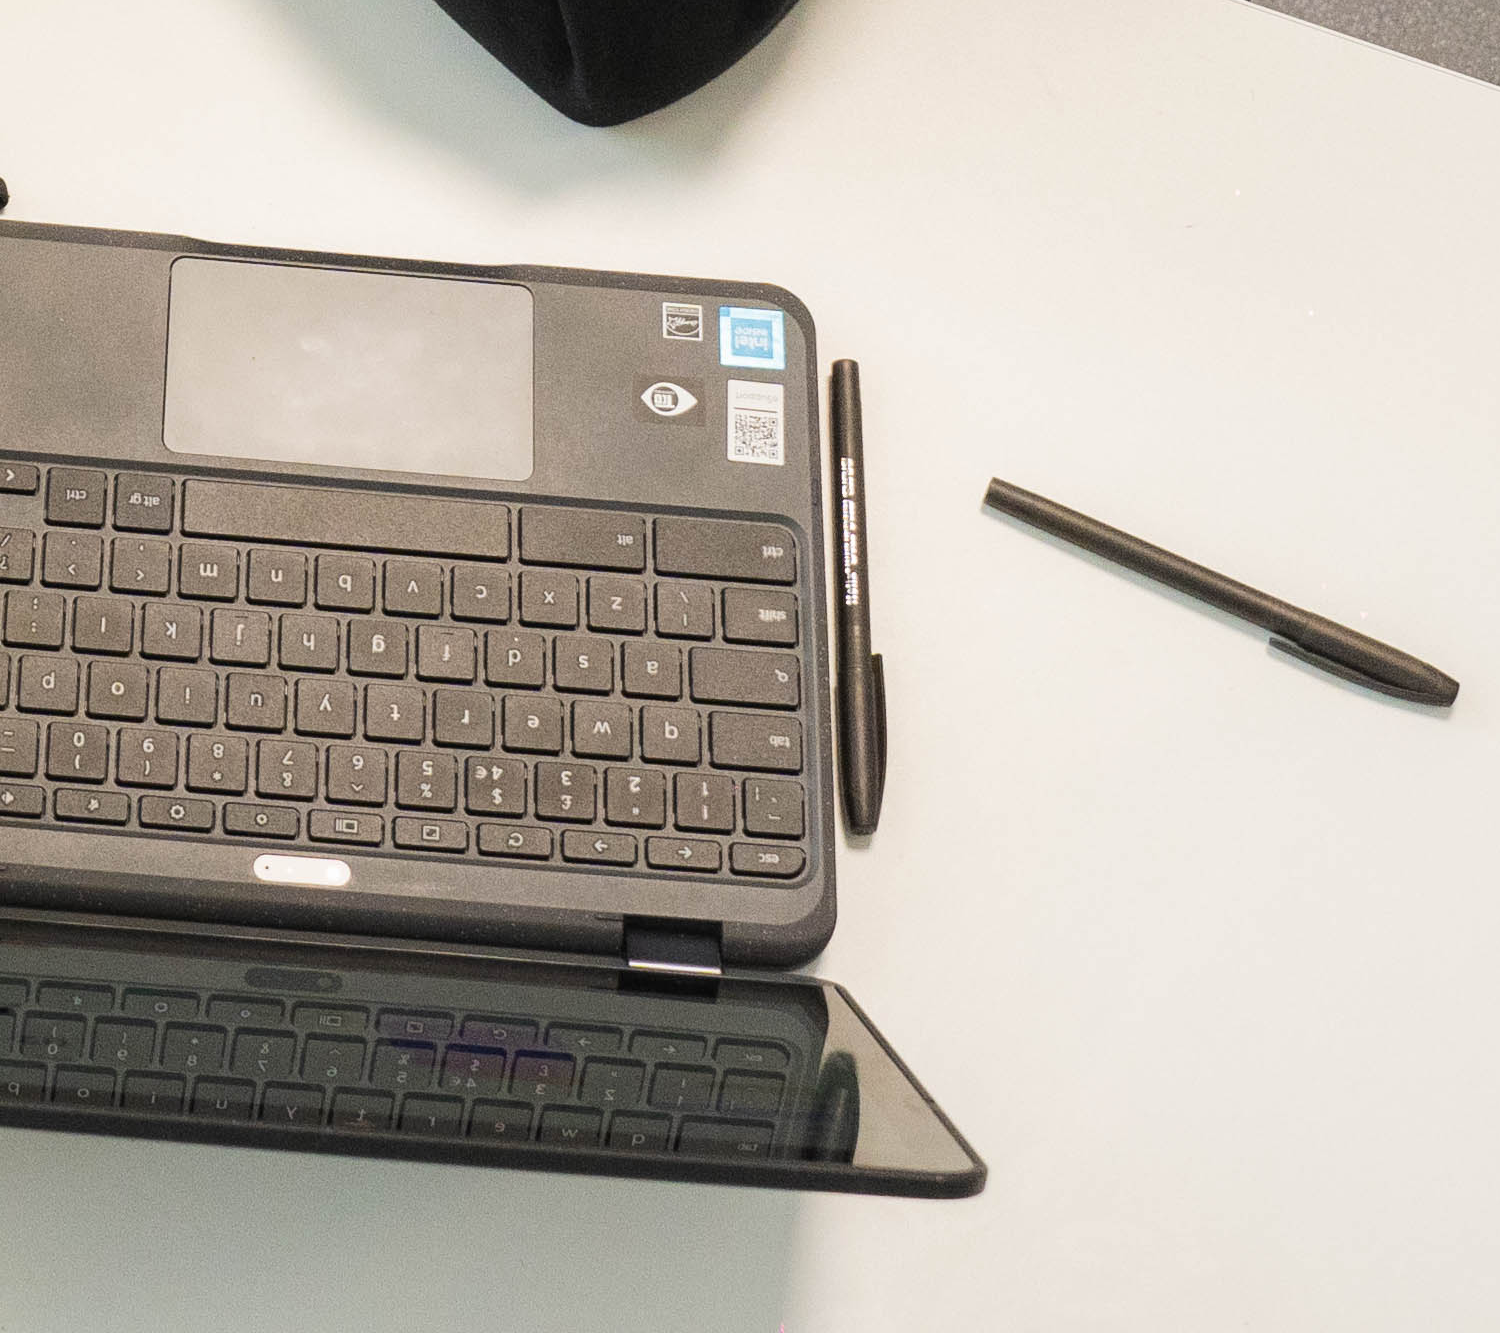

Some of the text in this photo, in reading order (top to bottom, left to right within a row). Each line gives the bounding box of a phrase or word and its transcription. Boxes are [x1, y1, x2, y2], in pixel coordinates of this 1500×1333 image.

[734, 336, 769, 350] intel
[67, 489, 783, 558] ctrl alt alt gr ctrl
[199, 563, 218, 577] m
[271, 569, 282, 582] n
[339, 574, 352, 591] b
[407, 580, 418, 593] v
[475, 585, 487, 598] c
[543, 591, 555, 604] x
[611, 597, 622, 609] z
[759, 608, 786, 622] shift
[165, 621, 177, 639] k
[236, 624, 245, 646] j
[303, 633, 315, 650] h
[372, 635, 385, 654] g
[442, 644, 451, 661] f
[508, 648, 521, 666] d
[578, 655, 589, 669] s
[646, 660, 659, 675] a
[42, 672, 55, 690] p
[111, 681, 125, 695] o
[250, 693, 263, 707] u
[319, 694, 332, 712] y
[390, 704, 400, 721] t
[461, 709, 470, 724] r
[528, 715, 539, 729] e
[594, 720, 611, 735] w
[665, 721, 678, 739] q
[73, 732, 85, 747] 0
[143, 738, 154, 753] 9
[769, 736, 790, 747] tab
[212, 743, 224, 758] 8
[282, 750, 294, 765] 7
[352, 754, 364, 770] 6
[422, 760, 434, 775] 5
[492, 766, 503, 779] 4
[561, 770, 573, 785] 3
[628, 776, 641, 792] 2
[702, 781, 709, 796] 1
[759, 853, 779, 864] esc
